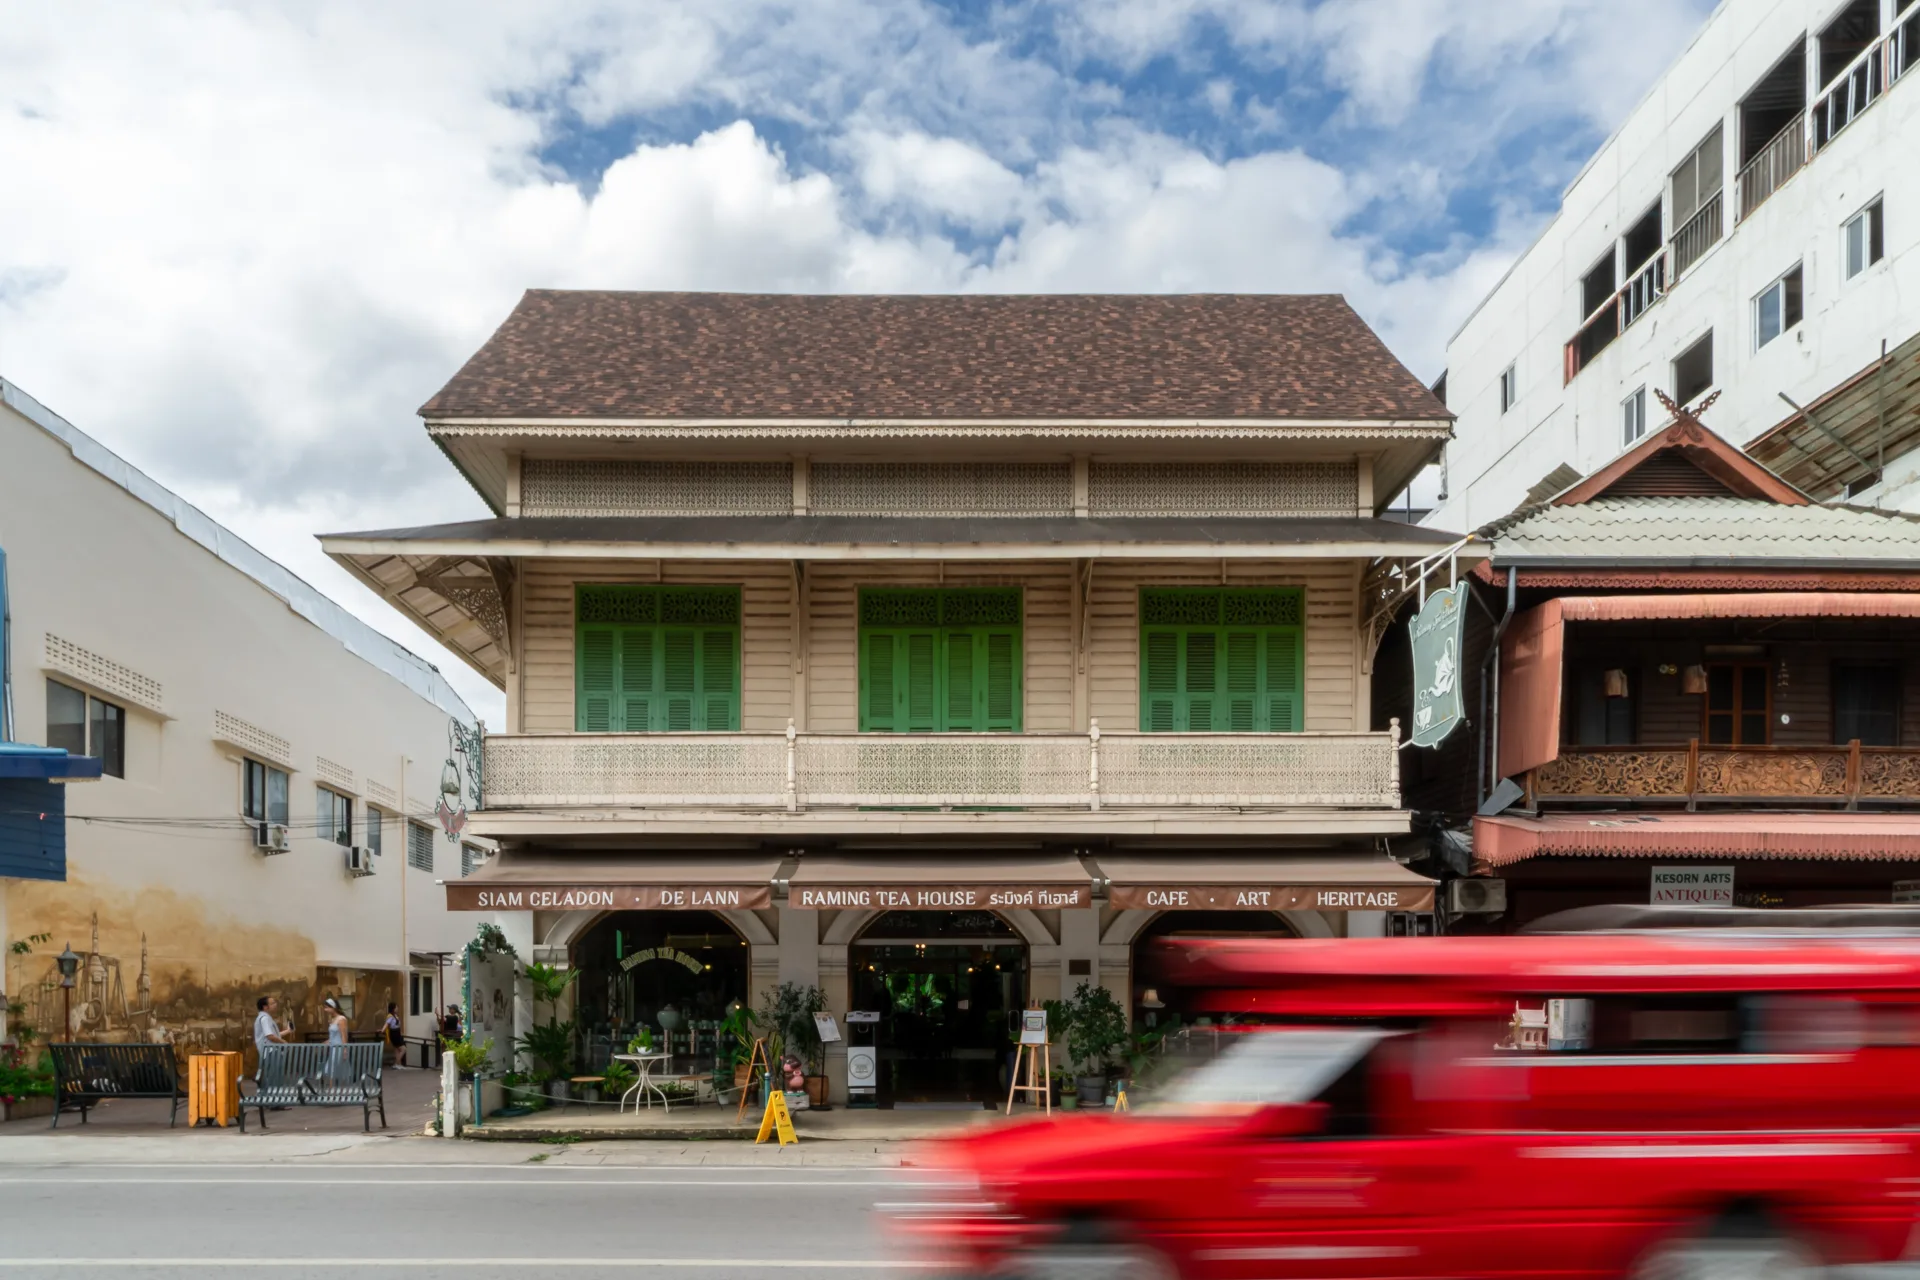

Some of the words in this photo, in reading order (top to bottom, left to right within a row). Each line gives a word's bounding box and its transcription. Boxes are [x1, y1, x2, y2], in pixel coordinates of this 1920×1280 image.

[1654, 873, 1699, 884] KESORN
[1702, 873, 1731, 884] ARTS
[478, 891, 523, 907] SIAM
[529, 890, 614, 907] CELADON
[660, 890, 685, 906] DE
[691, 890, 740, 906] LANN
[802, 890, 870, 906] RAMING
[876, 891, 911, 906] TEA
[917, 891, 976, 906] HOUSE
[989, 890, 1033, 905] ระมิงค์
[1038, 889, 1079, 905] ทีเฮาส์
[1147, 891, 1189, 906] CAFE
[1236, 891, 1271, 906] ART
[1317, 891, 1398, 907] HERITAGE
[1654, 889, 1731, 903] ANTIQUES
